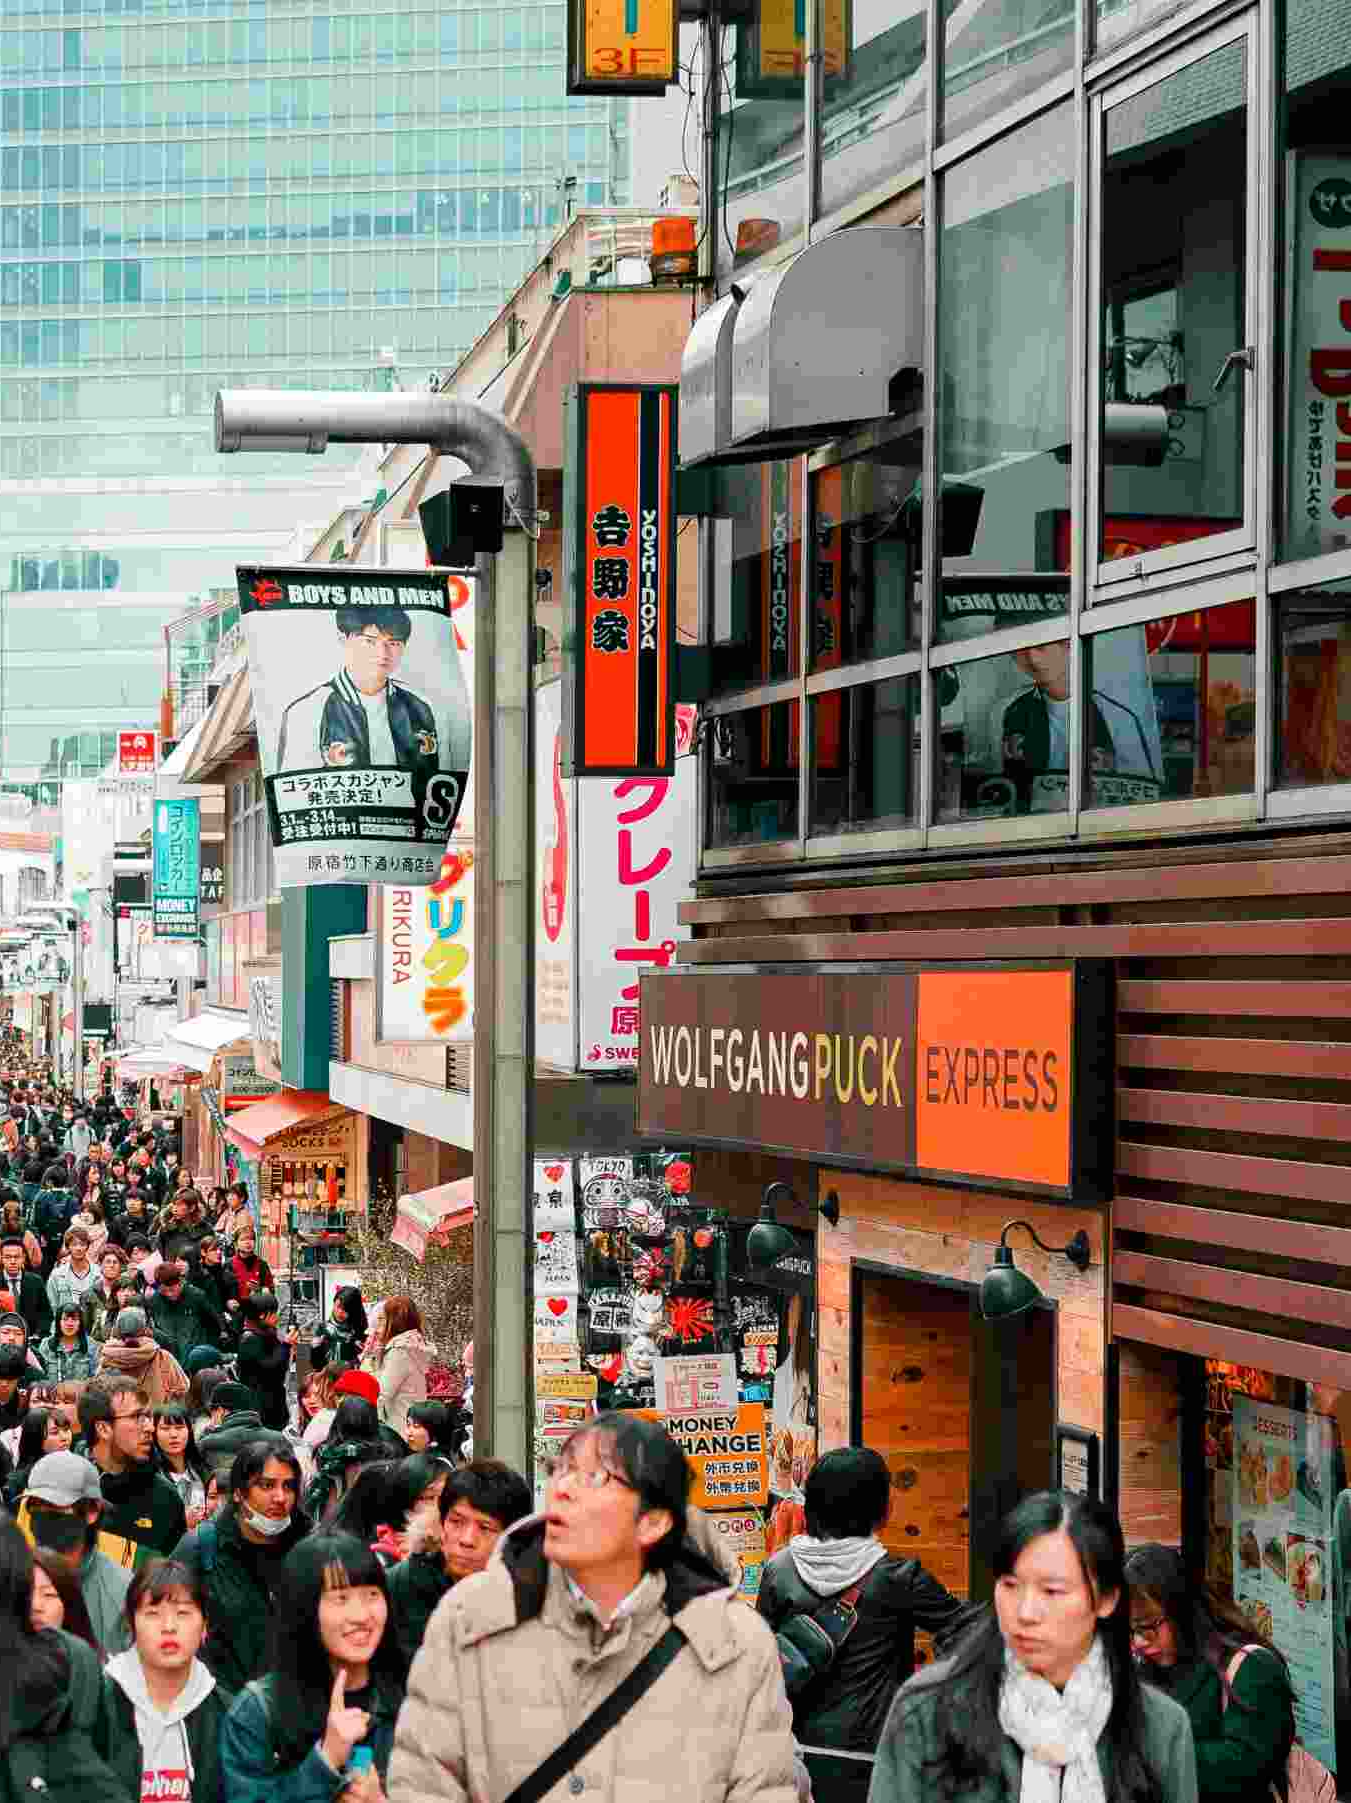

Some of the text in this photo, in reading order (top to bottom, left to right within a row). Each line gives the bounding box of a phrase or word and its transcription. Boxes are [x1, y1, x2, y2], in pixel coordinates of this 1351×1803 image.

[288, 585, 444, 607] BOYS AND MEN
[593, 505, 631, 651] 吉野家
[641, 509, 657, 649] YOSHINOYA
[650, 1024, 903, 1107] WOLFGANG PUCK
[926, 1046, 1059, 1113] EXPRESS
[281, 1136, 325, 1149] SOCKS
[670, 1417, 737, 1433] MONEY
[682, 1434, 761, 1455] HANGE
